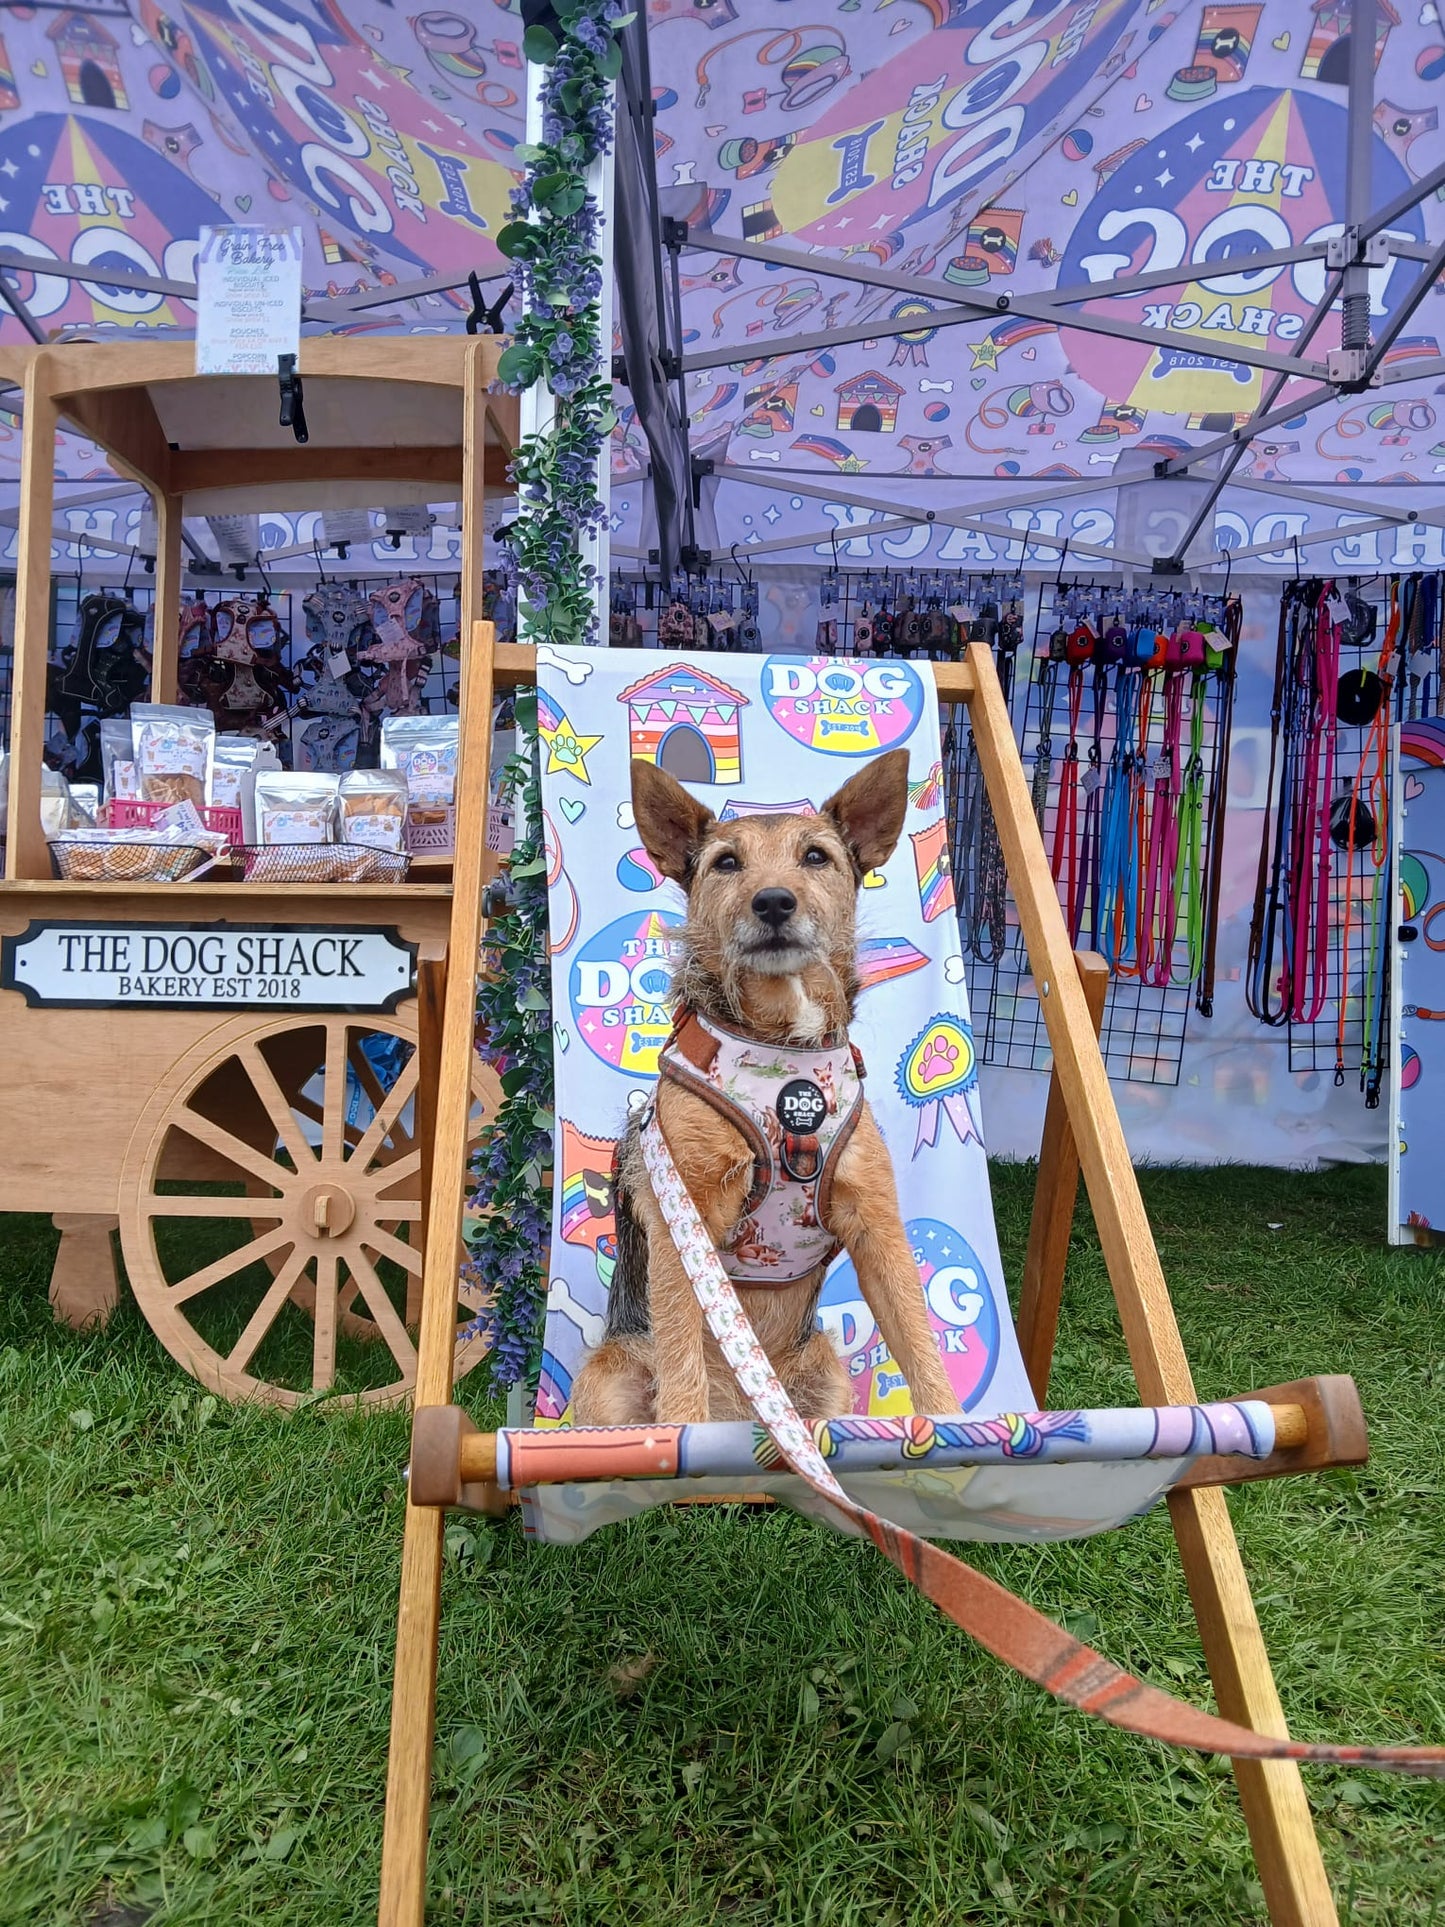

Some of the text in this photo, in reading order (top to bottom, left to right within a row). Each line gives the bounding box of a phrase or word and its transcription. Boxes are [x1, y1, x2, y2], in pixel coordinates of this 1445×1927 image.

[220, 237, 285, 256] Grain Free
[231, 251, 275, 270] Bakery
[767, 664, 913, 699] DOG
[794, 699, 895, 715] SHACK
[58, 935, 365, 977] THE DOG SHACK
[118, 976, 301, 998] BAKERY EST 2018
[574, 957, 673, 1007] DO
[602, 1005, 670, 1027] SHA
[784, 1096, 824, 1112] DOG
[817, 1265, 985, 1358] DG
